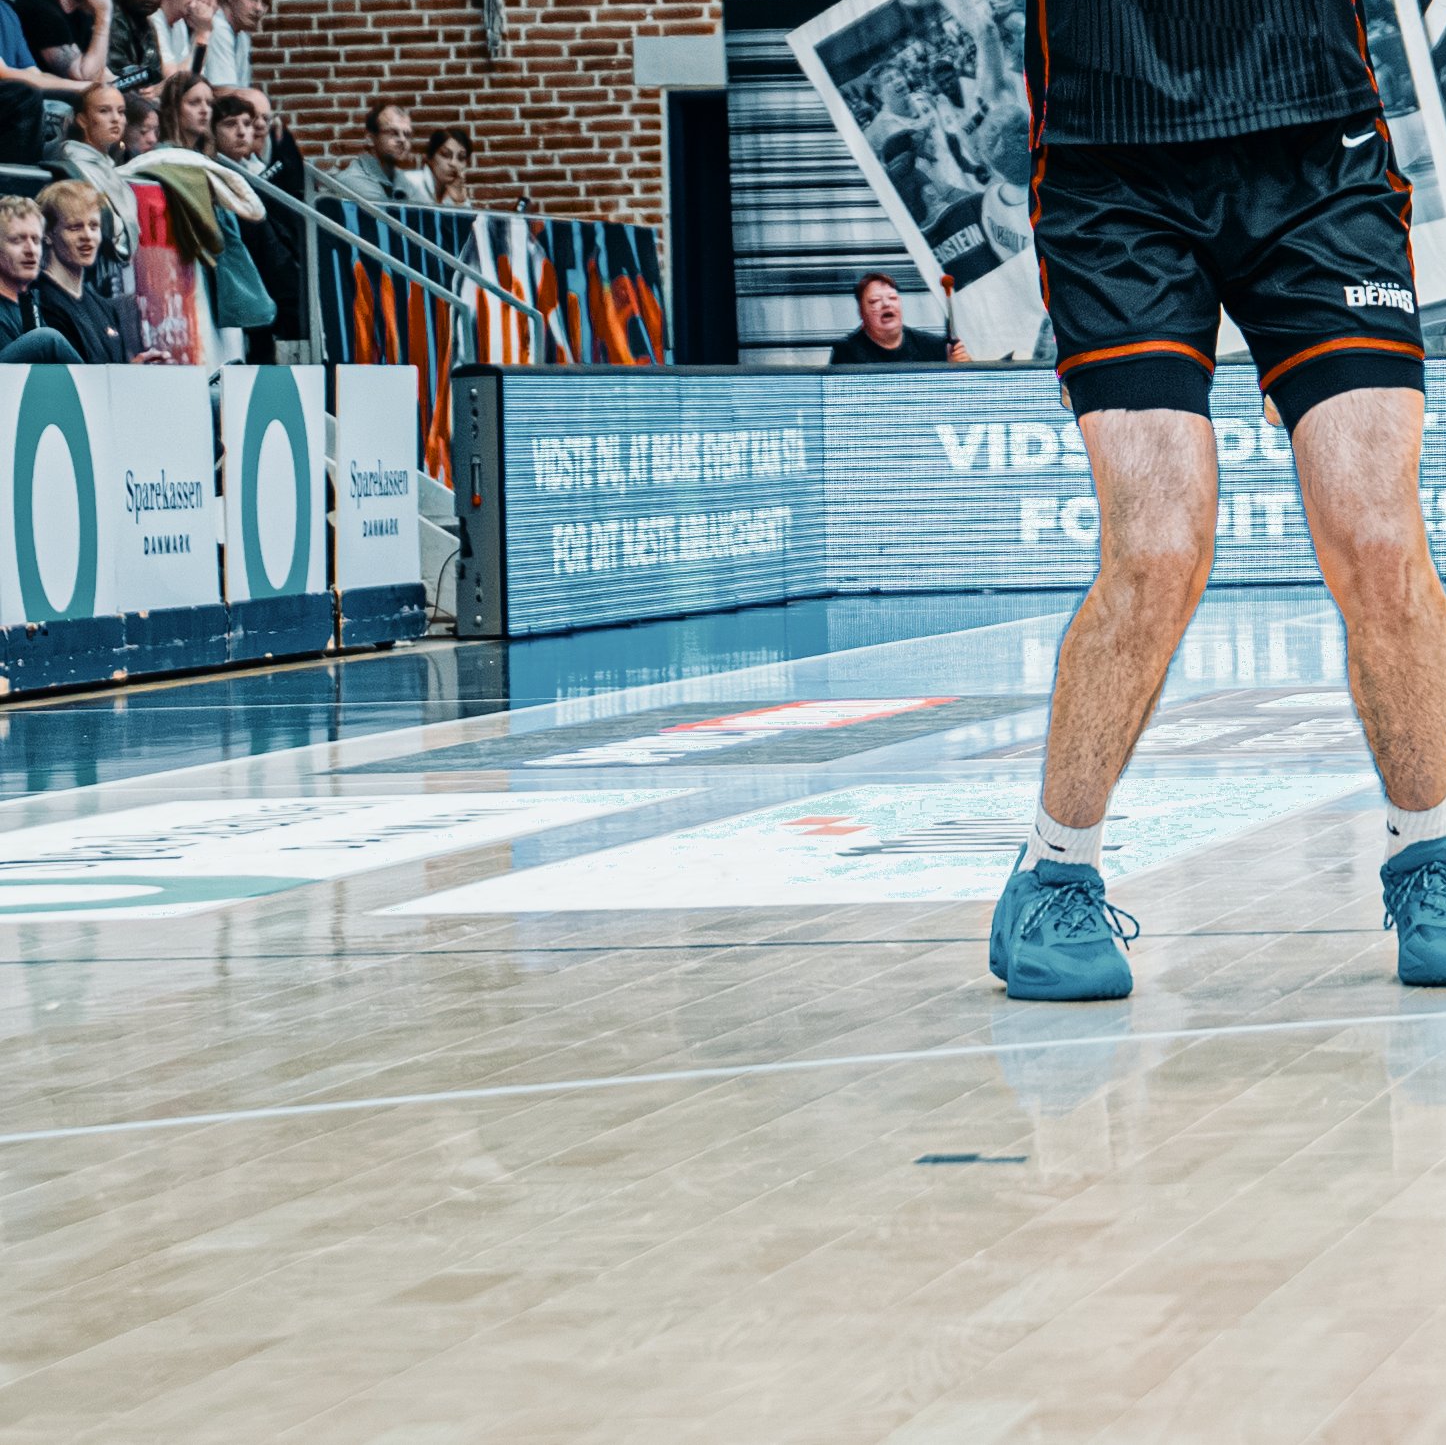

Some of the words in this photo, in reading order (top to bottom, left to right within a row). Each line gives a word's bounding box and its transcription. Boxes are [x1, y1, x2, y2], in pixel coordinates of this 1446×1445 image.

[1344, 285, 1415, 314] BEARS
[935, 422, 1088, 469] VIDS
[125, 469, 203, 524] Sparekassen
[348, 459, 409, 509] Sparekassen
[362, 518, 399, 539] DANMARK
[1019, 497, 1100, 543] FO
[143, 534, 192, 555] DANMARK
